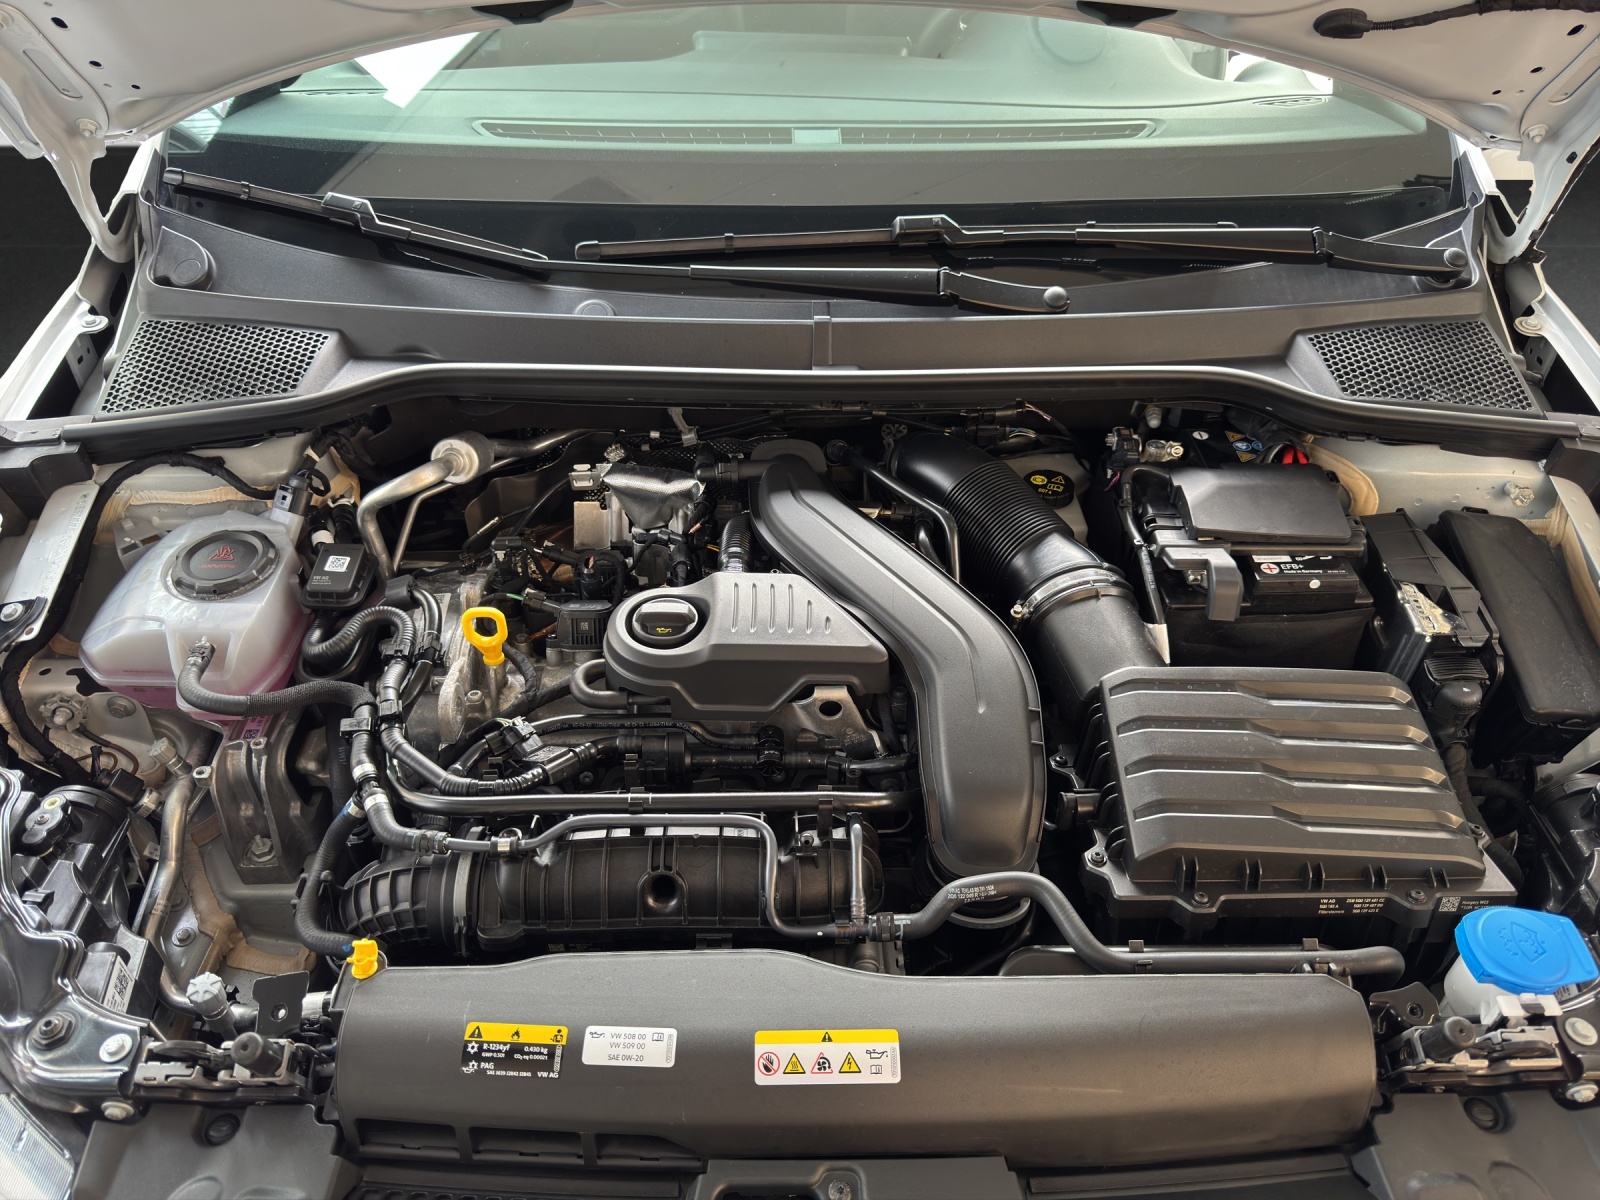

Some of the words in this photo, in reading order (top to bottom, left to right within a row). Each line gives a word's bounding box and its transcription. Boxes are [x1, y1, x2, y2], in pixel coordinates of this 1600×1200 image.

[483, 1043, 510, 1052] R-1234yf
[540, 1046, 548, 1054] kg
[621, 1054, 644, 1062] 0W-20
[480, 1062, 494, 1070] PAG
